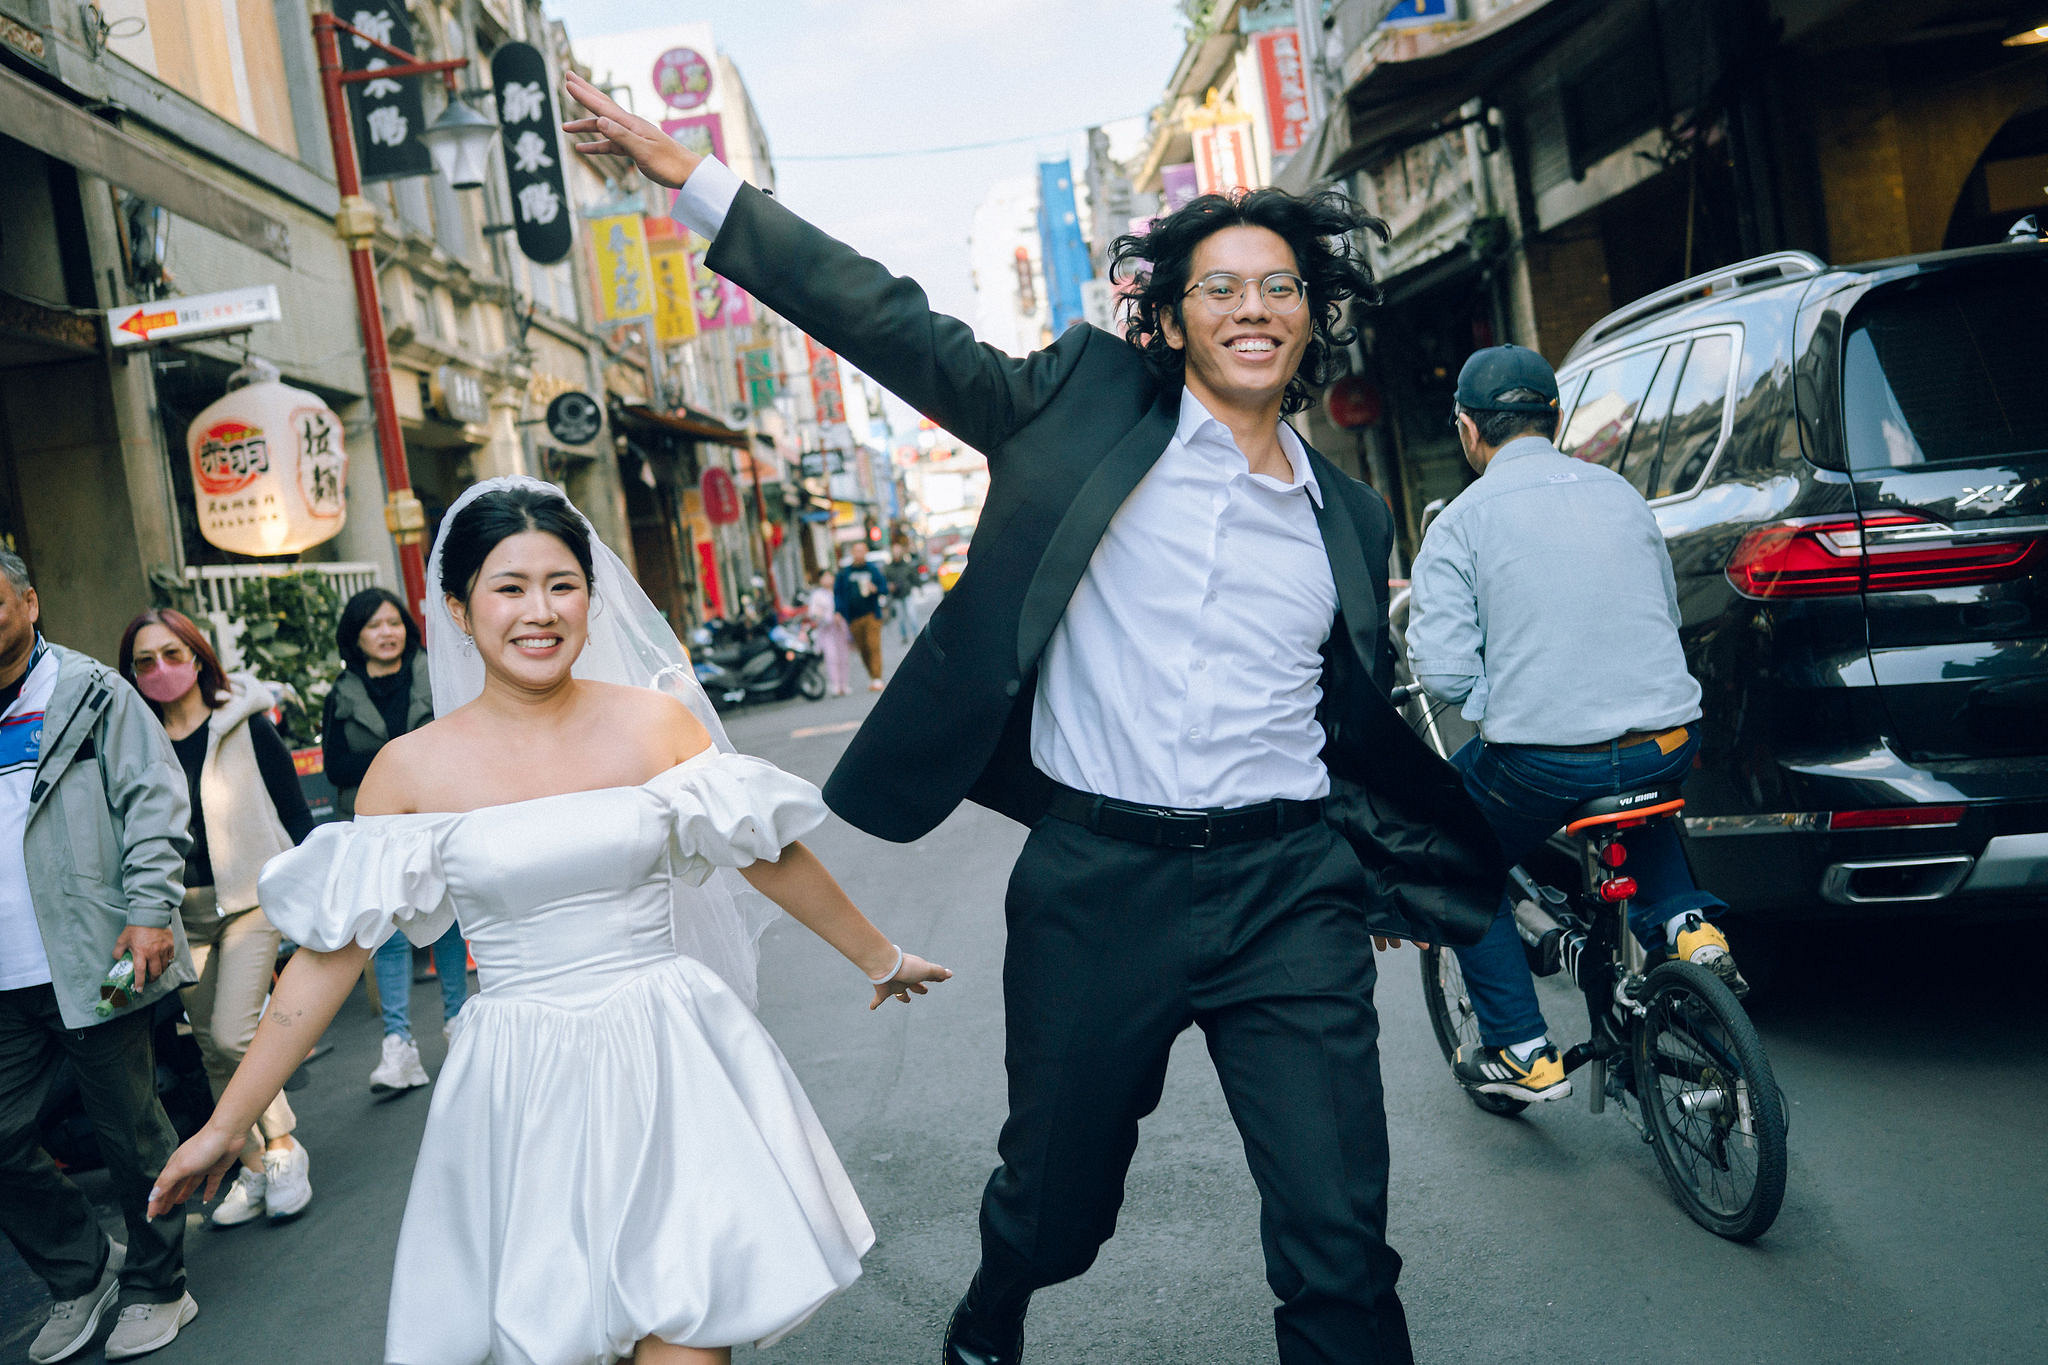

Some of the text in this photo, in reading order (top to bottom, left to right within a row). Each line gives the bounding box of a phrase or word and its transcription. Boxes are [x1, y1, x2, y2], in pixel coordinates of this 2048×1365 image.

[502, 80, 561, 225] 新東陽
[1955, 482, 2027, 507] X7
